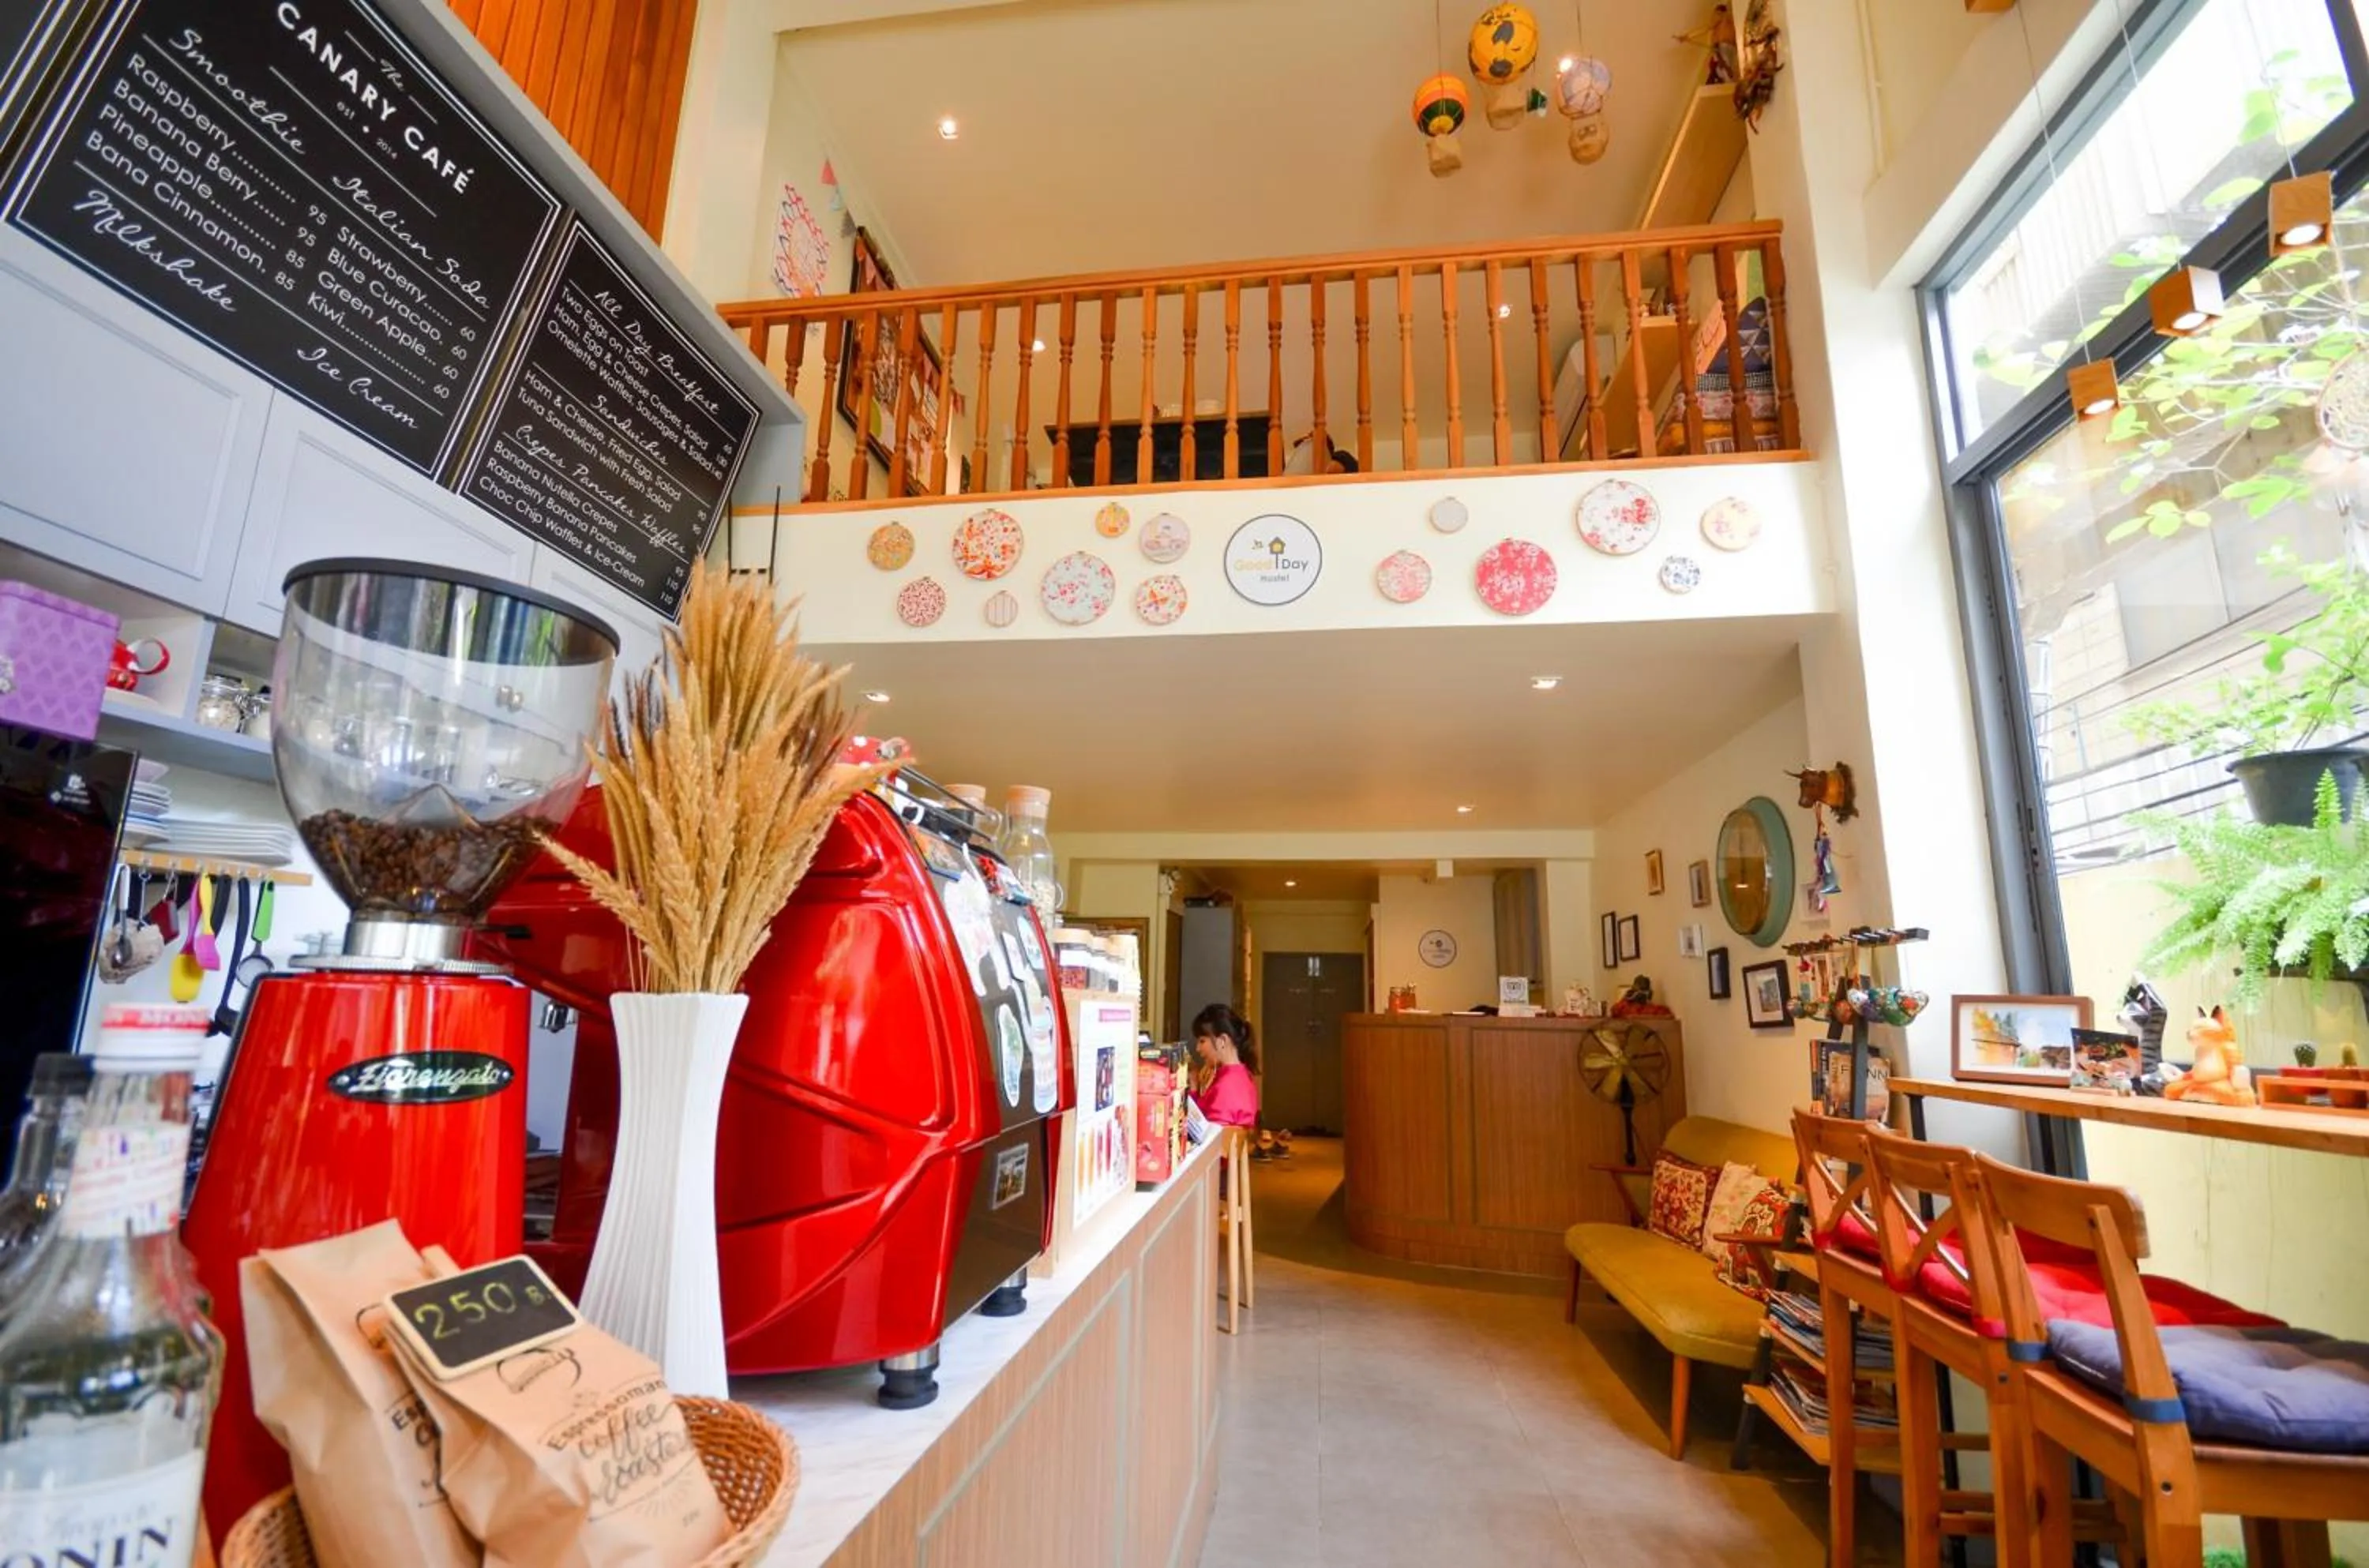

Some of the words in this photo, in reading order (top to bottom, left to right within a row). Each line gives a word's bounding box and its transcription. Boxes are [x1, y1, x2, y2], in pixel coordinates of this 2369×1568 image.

[127, 54, 235, 151] Raspberry
[309, 204, 328, 225] 95
[168, 28, 306, 154] Smoothie
[278, 2, 396, 121] CANARY
[404, 126, 474, 194] CAFÉ
[86, 130, 149, 186] Bana
[276, 271, 295, 291] 85
[99, 104, 212, 198] Pineapple
[285, 249, 306, 268] 85
[114, 79, 202, 158] Banana
[205, 152, 257, 201] Berry
[298, 227, 317, 247] 95
[73, 189, 237, 312] Milkshake
[332, 176, 434, 261] Italian
[436, 257, 490, 309] Soda
[337, 226, 427, 304] Strawberry
[460, 326, 475, 342] 60
[307, 291, 345, 325] Kiwi
[434, 384, 449, 399] 60
[318, 271, 374, 318] Green
[376, 316, 427, 357] Apple
[442, 365, 459, 380] 60
[328, 247, 366, 283] Blue
[451, 345, 467, 361] 60
[561, 286, 583, 314] Two
[584, 309, 608, 339] Eggs
[609, 336, 623, 354] on
[625, 348, 648, 377] Toast
[595, 291, 622, 319] All
[625, 320, 653, 355] Day
[657, 352, 720, 415] Breakfast
[297, 347, 344, 381] Ice
[348, 377, 419, 430] Cream
[524, 369, 552, 400] Ham
[554, 396, 561, 407] &
[607, 438, 633, 464] Fried
[655, 475, 681, 502] Salad
[547, 320, 597, 371] Omelette
[636, 400, 678, 443] Sausages
[679, 438, 687, 451] &
[688, 445, 712, 471] Salad
[583, 330, 603, 358] Egg
[604, 352, 612, 365] &
[614, 361, 650, 397] Cheese
[684, 423, 708, 450] Salad
[591, 394, 669, 466] Sandwiches
[494, 440, 540, 480] Banana
[541, 473, 580, 508] Nutella
[581, 501, 618, 534] Crepes
[516, 425, 566, 469] Crepes
[572, 463, 636, 520] Pancakes
[640, 512, 686, 554] Waffles
[518, 386, 545, 416] Tuna
[546, 410, 599, 458] Sandwich
[599, 452, 619, 474] with
[621, 467, 645, 494] Fresh
[646, 486, 672, 513] Salad
[479, 475, 513, 505] Choc
[515, 498, 543, 524] Chip
[545, 516, 584, 550] Waffles
[584, 542, 592, 556] &
[594, 549, 645, 588] Ice-Cream
[486, 457, 545, 506] Raspberry
[546, 496, 589, 533] Banana
[590, 526, 637, 565] Pancakes
[1282, 557, 1309, 573] Day
[415, 1282, 517, 1340] 250
[579, 1402, 673, 1461] coffee
[0, 1515, 173, 1568] ONIN
